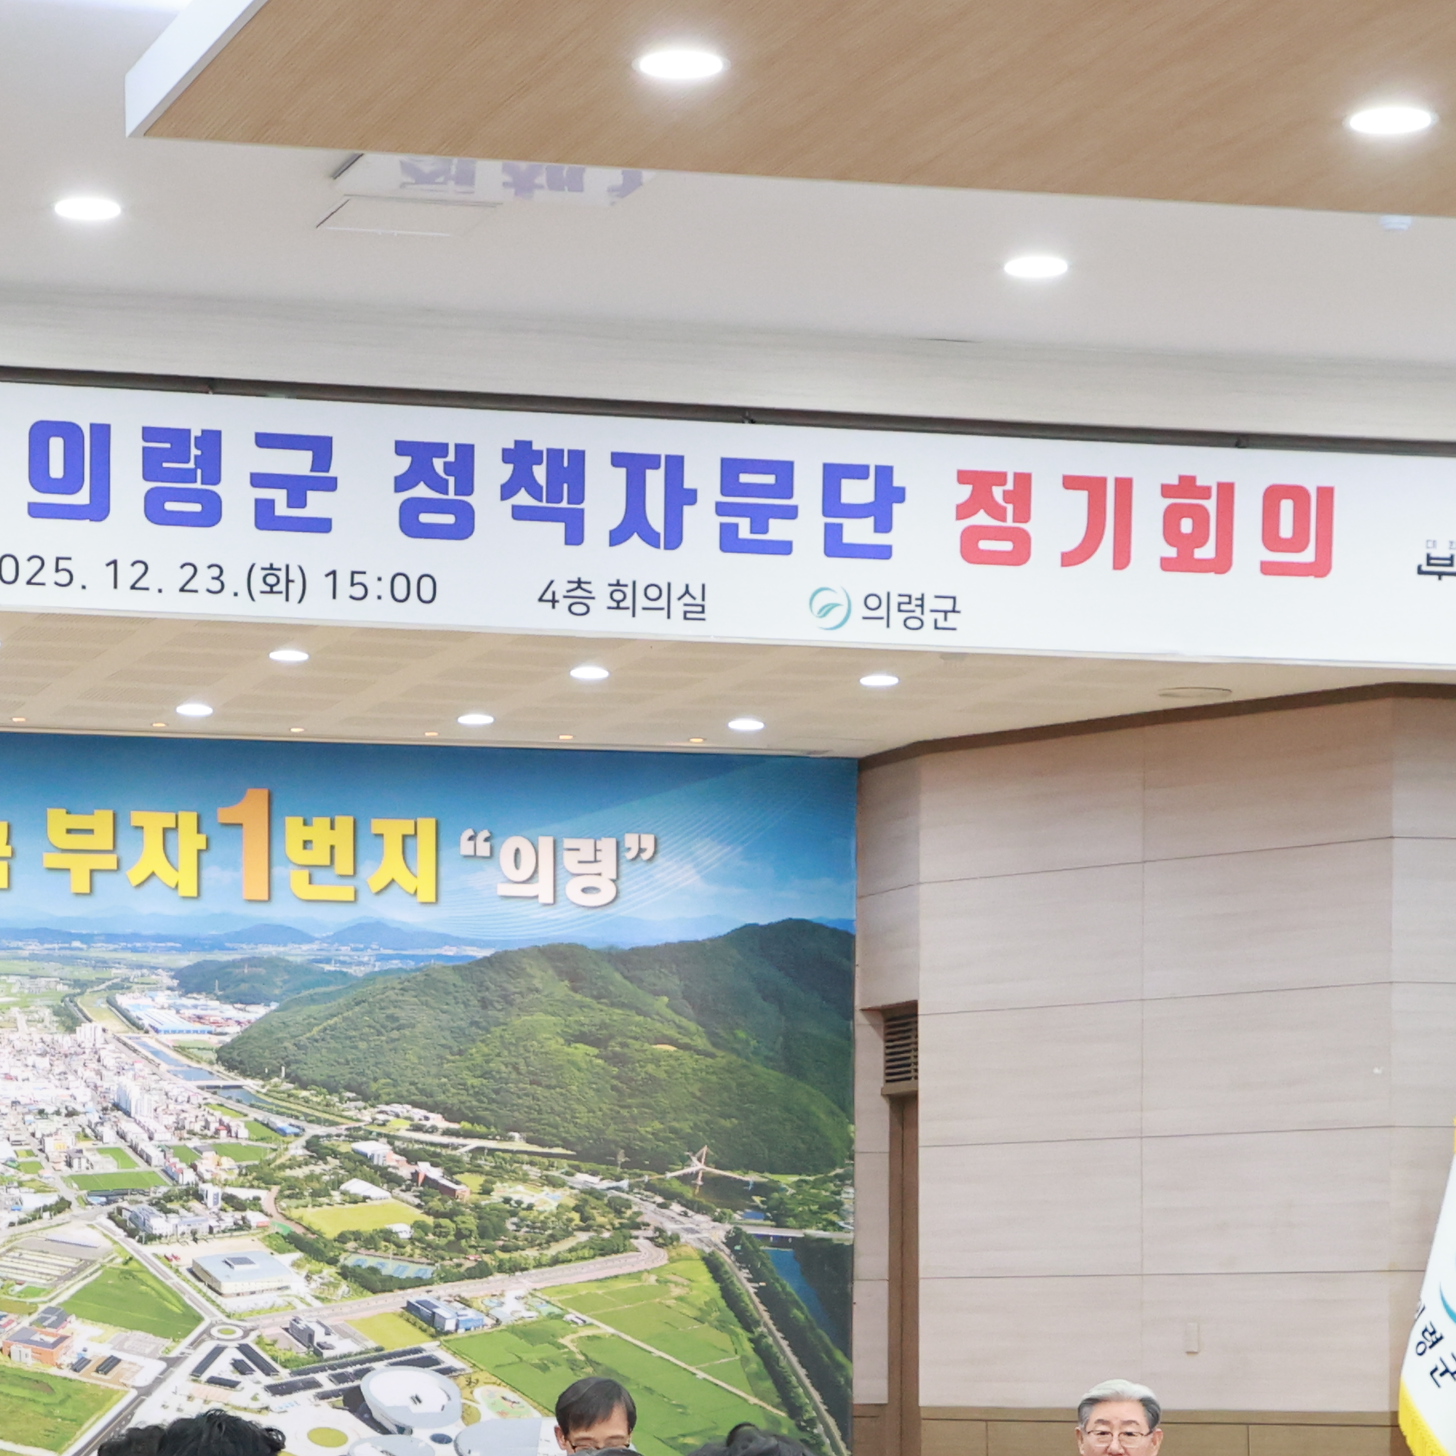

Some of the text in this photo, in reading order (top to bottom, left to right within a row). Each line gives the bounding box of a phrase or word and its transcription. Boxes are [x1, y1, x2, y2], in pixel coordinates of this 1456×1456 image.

[28, 420, 338, 534] 의령군
[394, 438, 906, 560] 정책자문단
[955, 469, 1336, 579] 정기회의
[105, 558, 164, 594] 12.
[324, 569, 438, 605] 15:00
[537, 576, 708, 622] 4층 회의실
[861, 591, 962, 632] 의령군
[43, 788, 438, 903] 부자1번지
